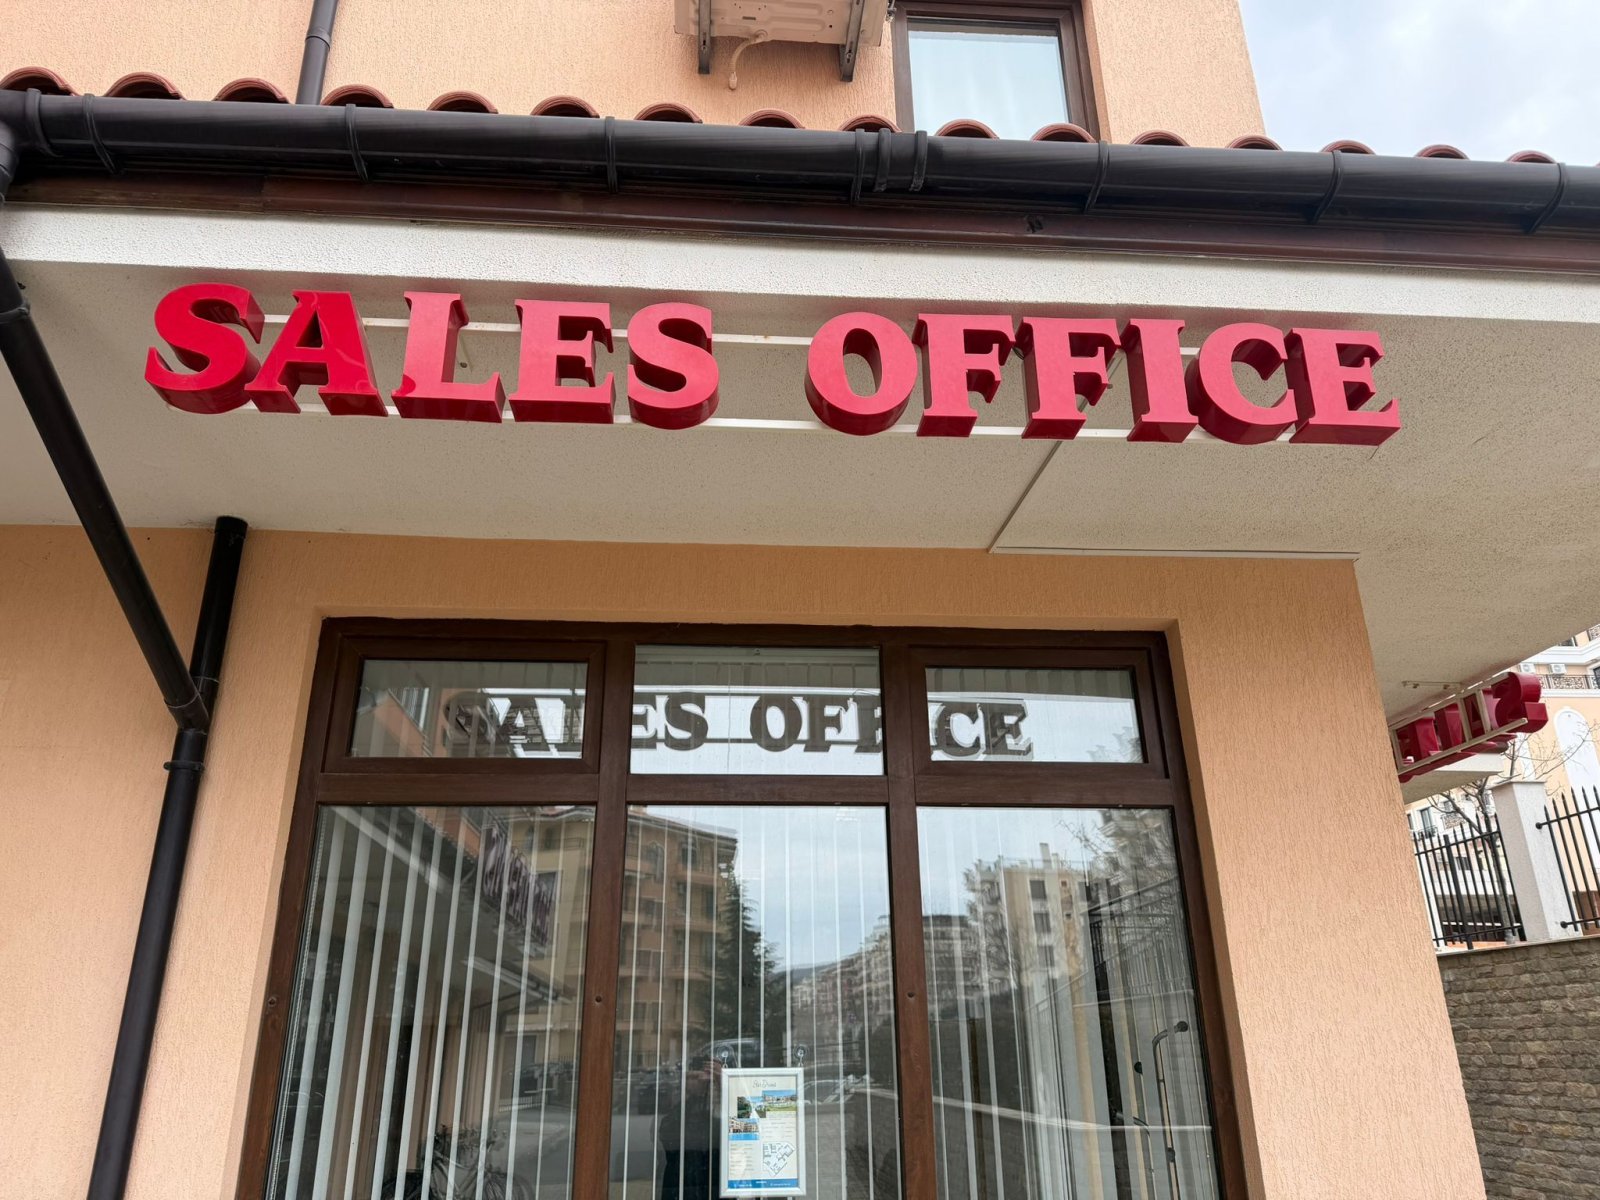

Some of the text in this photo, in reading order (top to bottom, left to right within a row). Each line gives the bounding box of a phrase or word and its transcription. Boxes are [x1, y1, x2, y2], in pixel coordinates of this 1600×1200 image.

[145, 282, 1401, 445] SALES OFFICE
[443, 689, 709, 753] SAES
